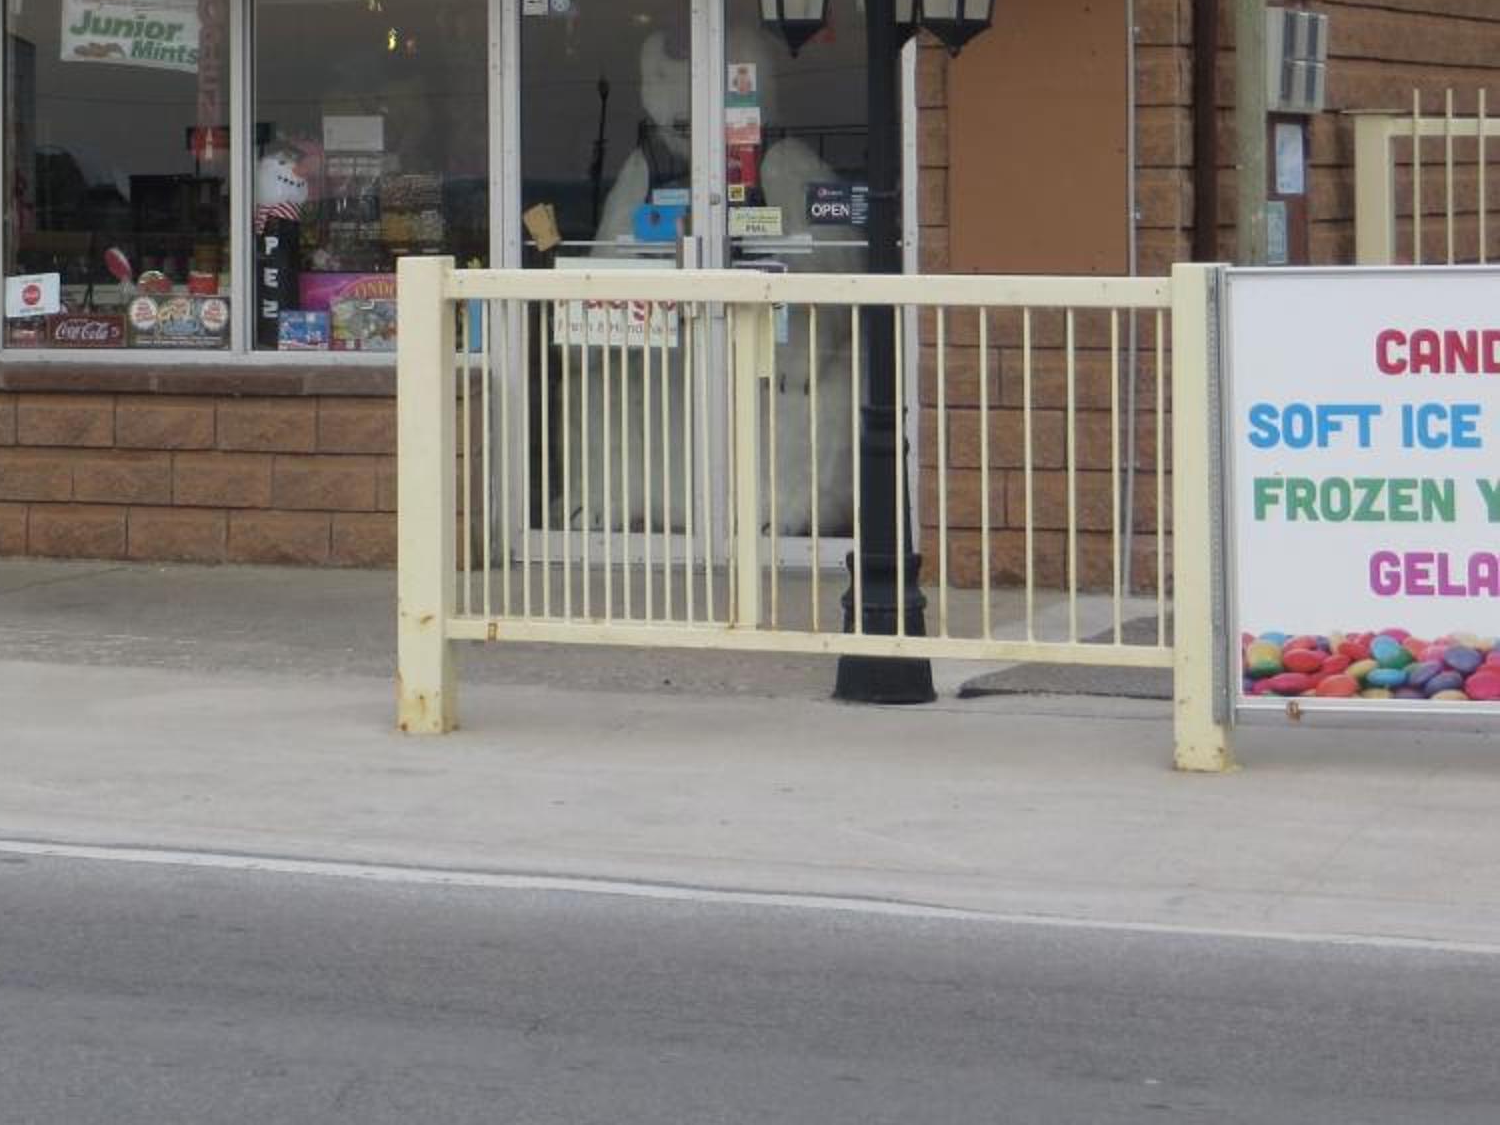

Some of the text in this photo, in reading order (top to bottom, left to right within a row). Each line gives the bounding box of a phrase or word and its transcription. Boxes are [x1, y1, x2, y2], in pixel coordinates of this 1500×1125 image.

[69, 9, 184, 42] Junior
[131, 40, 199, 66] Mints
[811, 203, 850, 217] OPEN
[1247, 403, 1483, 449] SOFT ICE
[1253, 477, 1457, 523] FROZEN
[1369, 551, 1500, 597] GELA
